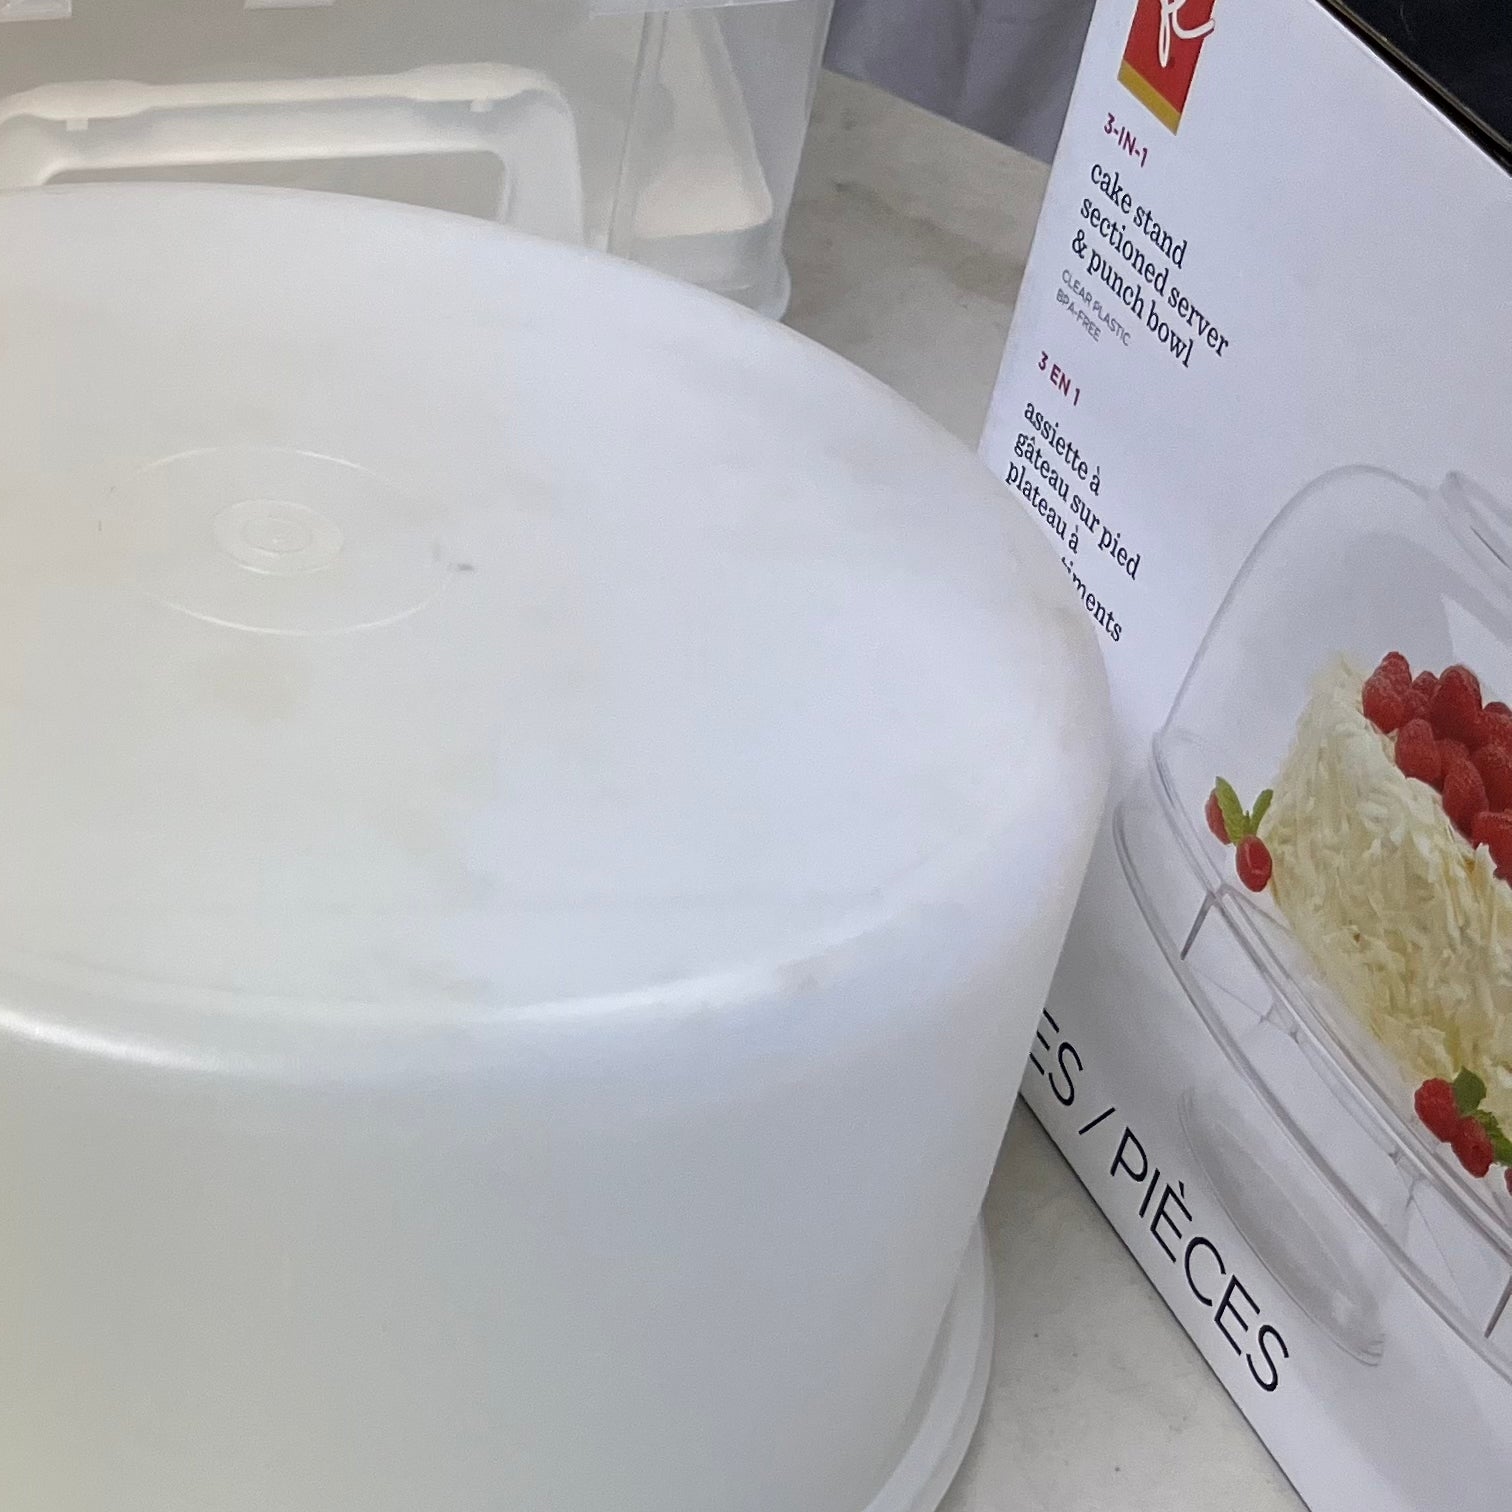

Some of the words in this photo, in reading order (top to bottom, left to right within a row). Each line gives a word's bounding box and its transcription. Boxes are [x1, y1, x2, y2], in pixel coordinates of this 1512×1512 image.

[1104, 112, 1148, 168] 3-IN-1
[1091, 164, 1132, 214] cake
[1133, 205, 1187, 269] stand
[1062, 269, 1093, 306] CLEAR
[1092, 300, 1131, 346] PLASTIC
[1072, 229, 1088, 259] &
[1087, 249, 1144, 319] punch
[1147, 300, 1194, 368] bowl
[1080, 199, 1170, 296] sectioned
[1168, 286, 1229, 357] server
[1038, 351, 1049, 371] 3
[1050, 365, 1071, 397] EN
[1073, 388, 1081, 406] 1
[1024, 403, 1088, 480] assiette
[1089, 465, 1101, 496] à
[1005, 462, 1067, 540] plateau
[1068, 525, 1080, 554] à
[1014, 433, 1069, 502] gâteau
[1070, 494, 1101, 533] sur
[1098, 526, 1141, 580] pied
[1110, 1127, 1290, 1393] PIÈCES
